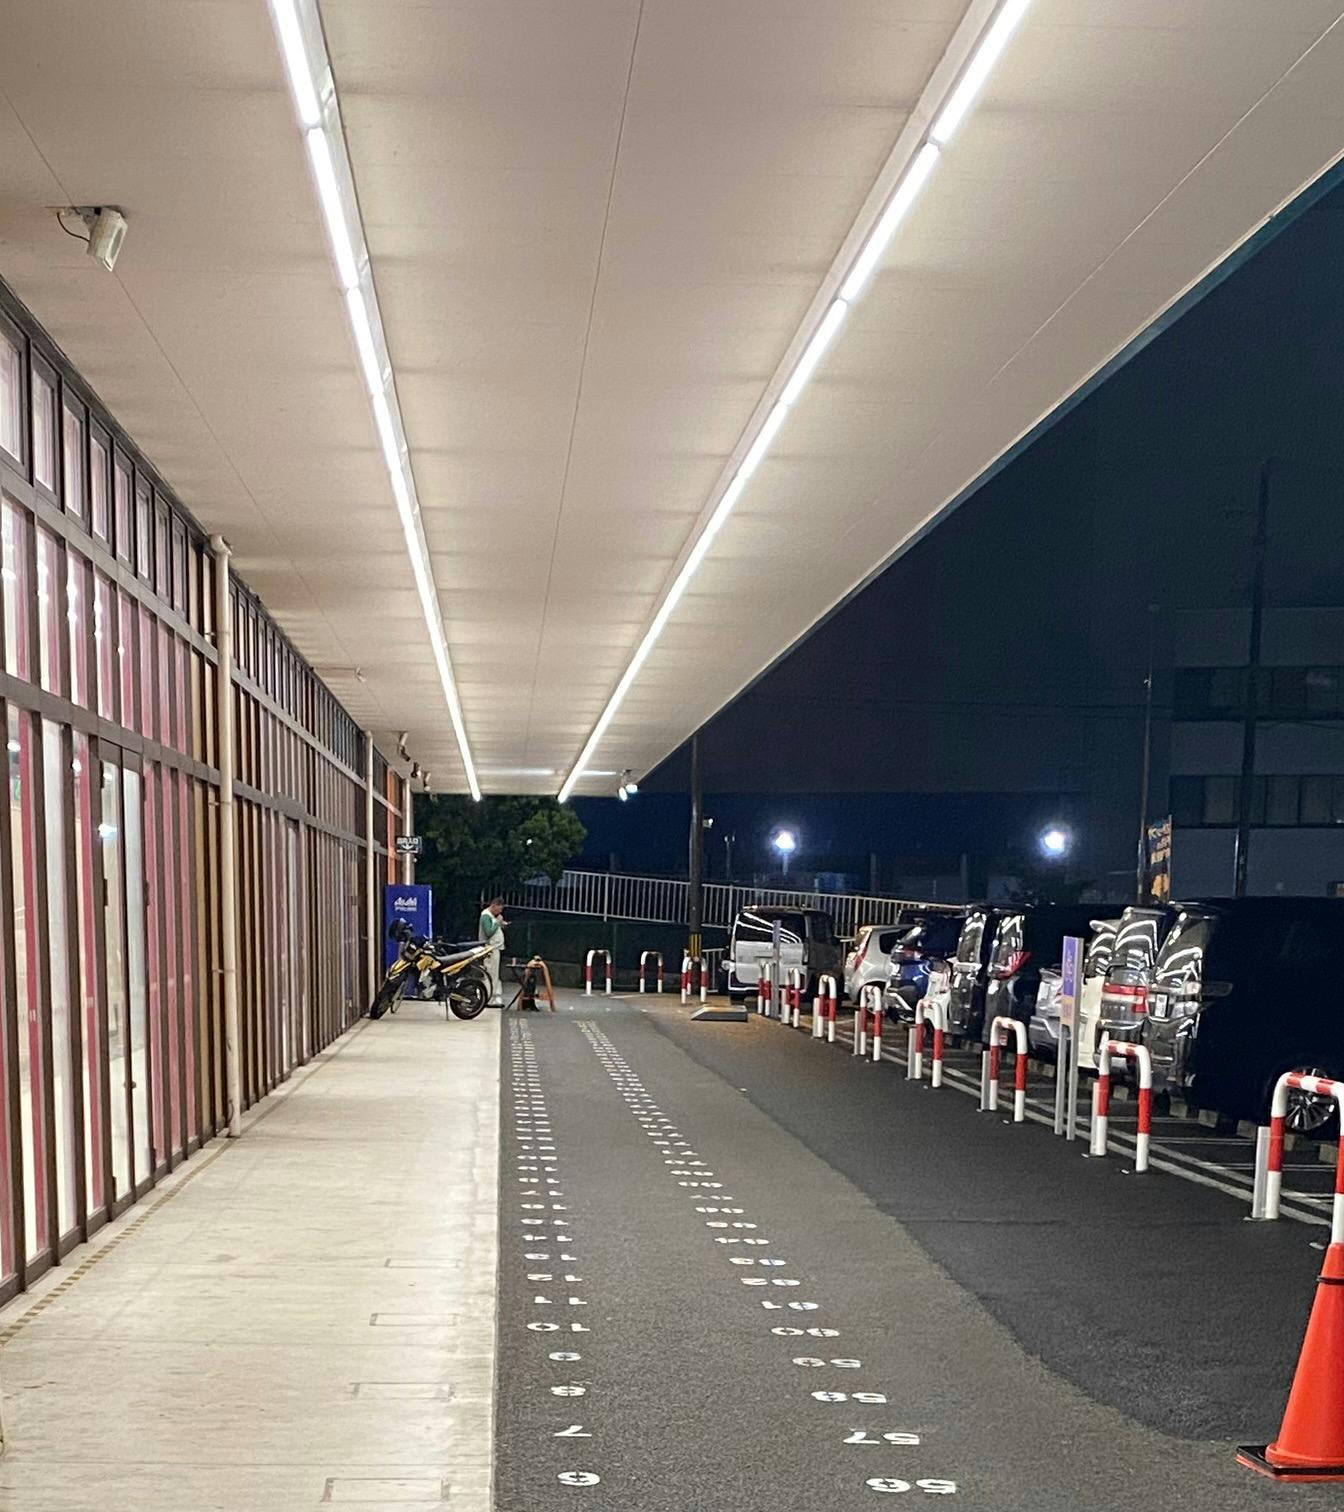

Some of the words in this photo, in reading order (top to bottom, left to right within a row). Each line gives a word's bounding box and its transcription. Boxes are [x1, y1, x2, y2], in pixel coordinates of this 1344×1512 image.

[527, 1273, 583, 1282] 12
[534, 1295, 588, 1305] 11
[761, 1300, 819, 1311] 61
[526, 1322, 591, 1332] 10
[771, 1327, 840, 1337] 60
[548, 1351, 582, 1361] 9
[792, 1357, 861, 1368] 59
[550, 1385, 586, 1397] 8
[811, 1390, 887, 1404] 58
[553, 1425, 593, 1437] 7
[842, 1431, 920, 1445] 57
[557, 1471, 601, 1486] 6
[865, 1478, 957, 1495] 56
